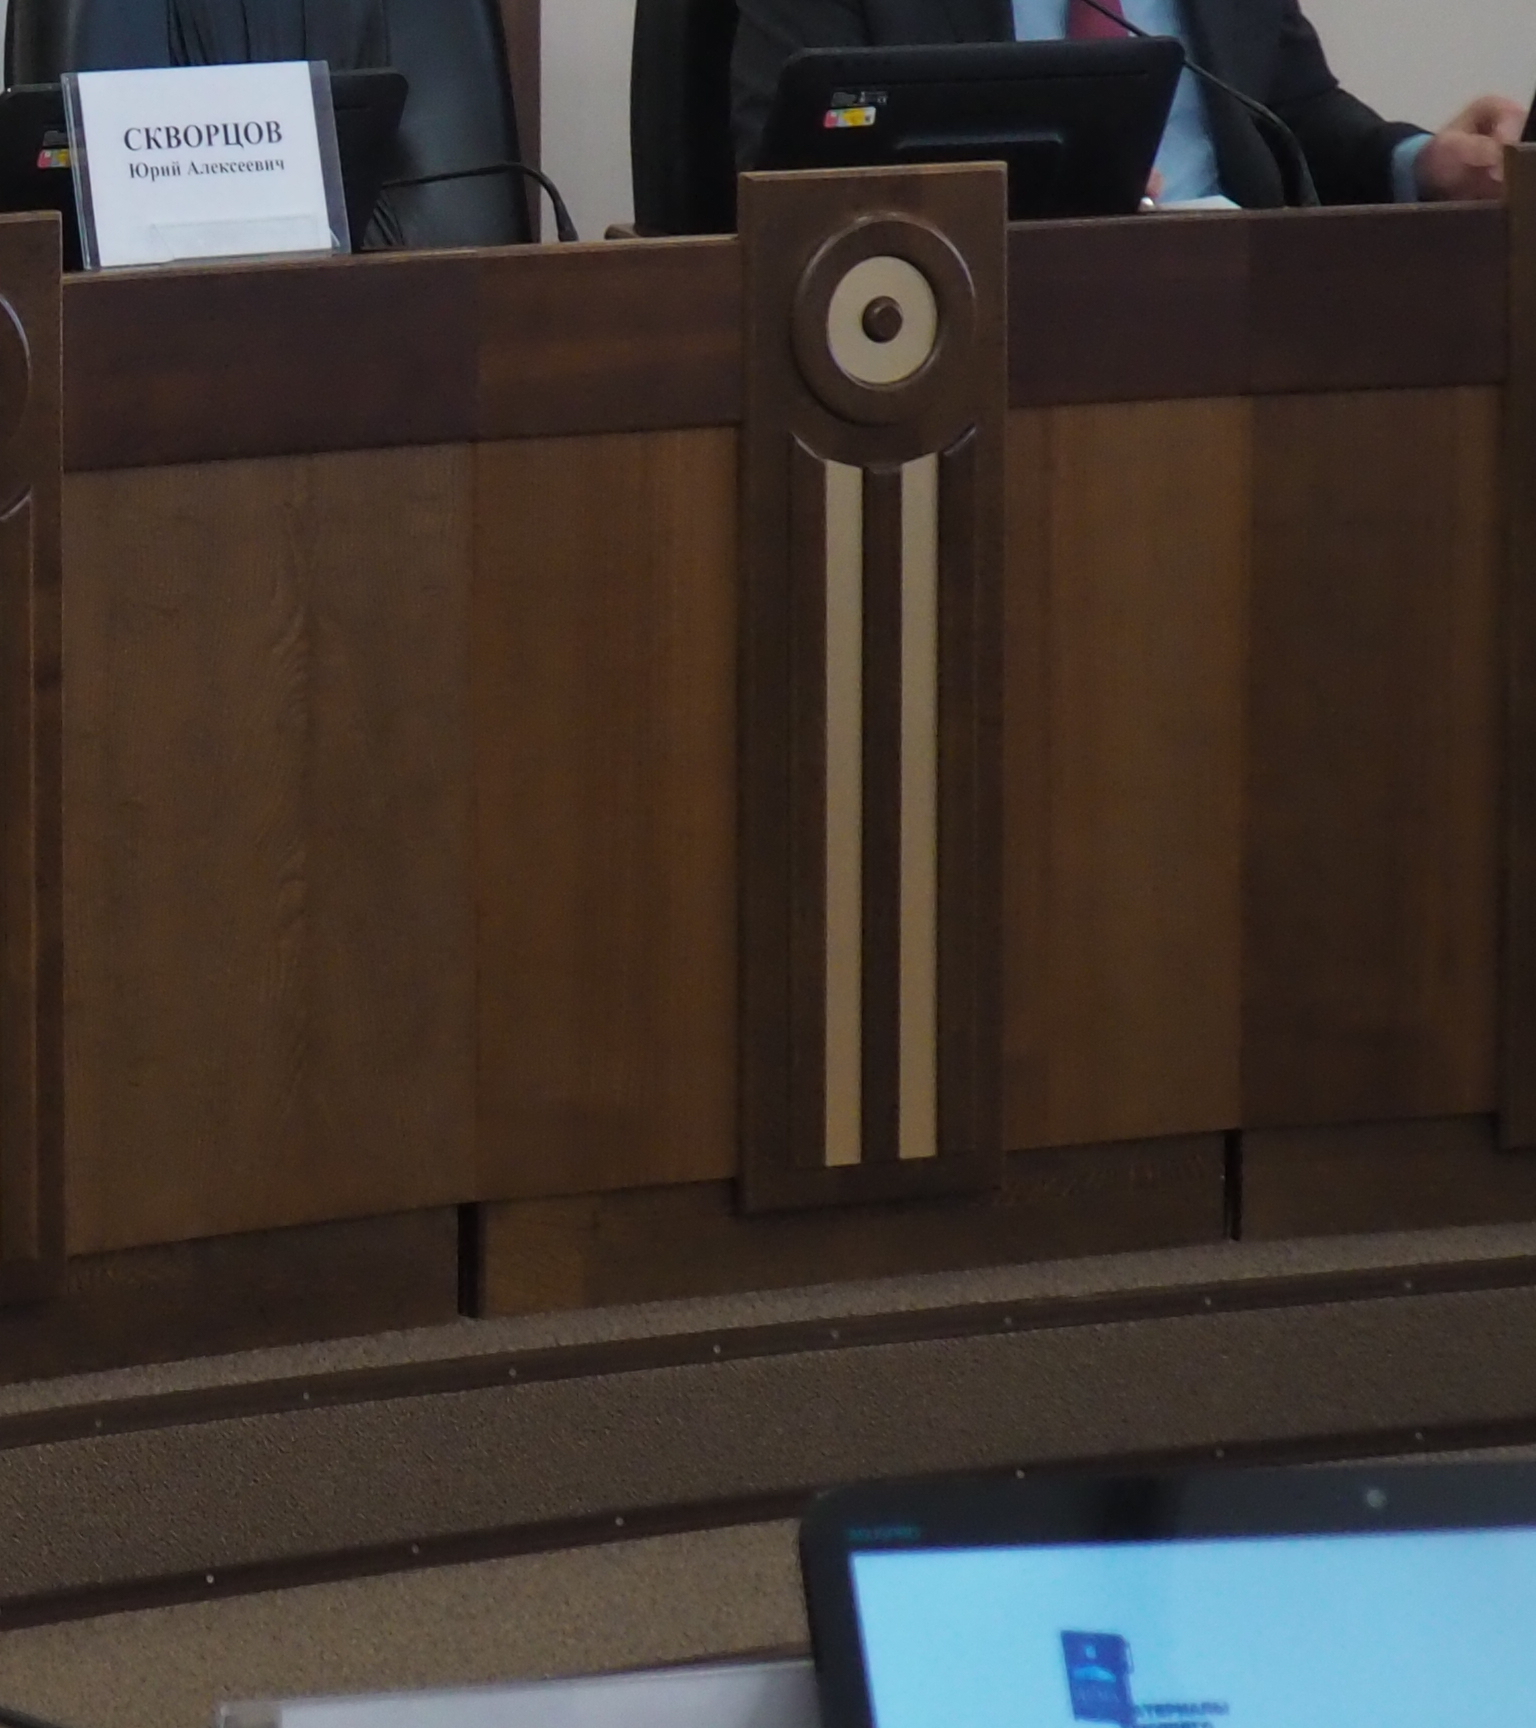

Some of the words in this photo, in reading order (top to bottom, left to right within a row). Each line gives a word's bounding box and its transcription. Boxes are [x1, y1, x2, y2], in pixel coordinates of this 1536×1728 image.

[123, 120, 283, 151] СКВОРЦОВ
[128, 161, 181, 182] Юрий
[186, 159, 285, 175] Алексеевич
